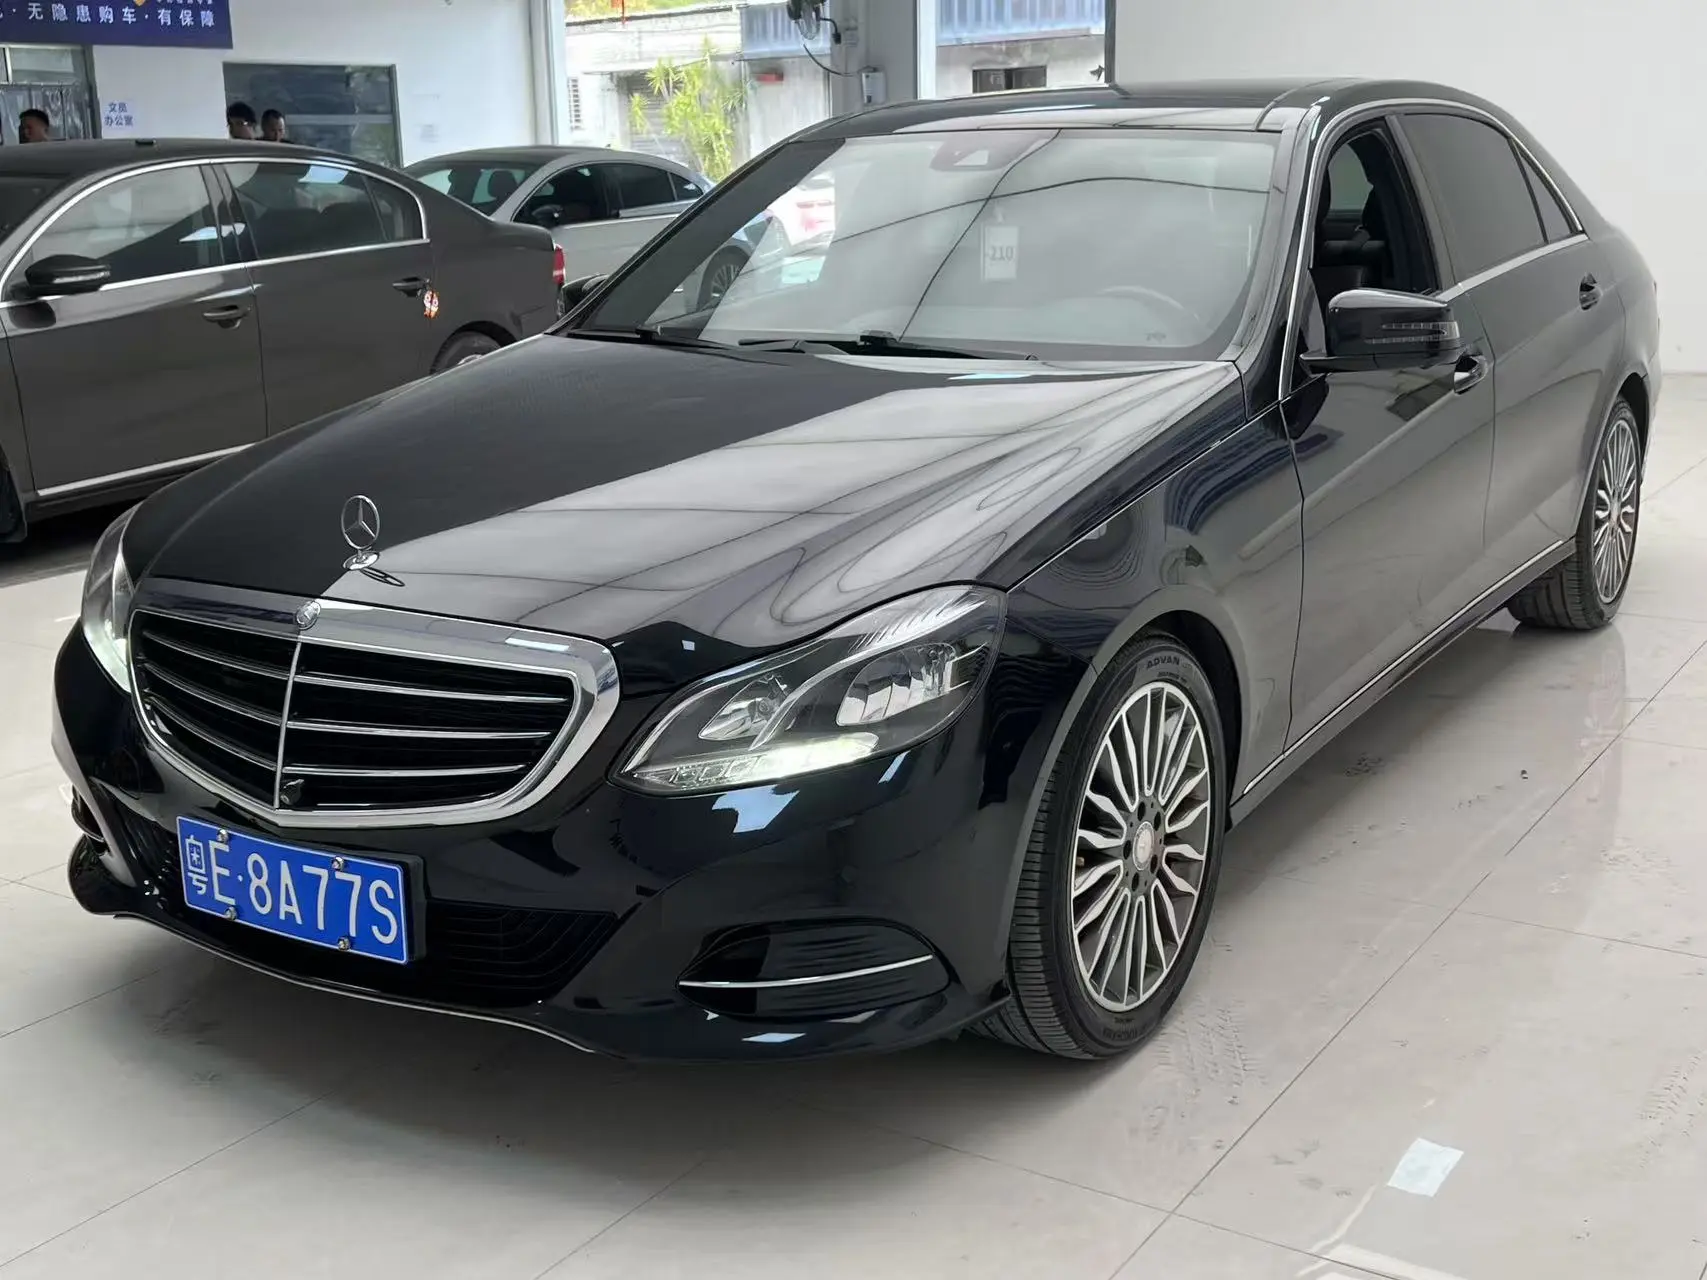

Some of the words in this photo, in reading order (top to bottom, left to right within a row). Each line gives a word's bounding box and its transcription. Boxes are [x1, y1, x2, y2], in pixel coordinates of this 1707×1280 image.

[104, 115, 134, 127] 办公室
[1147, 655, 1180, 669] ADVAN
